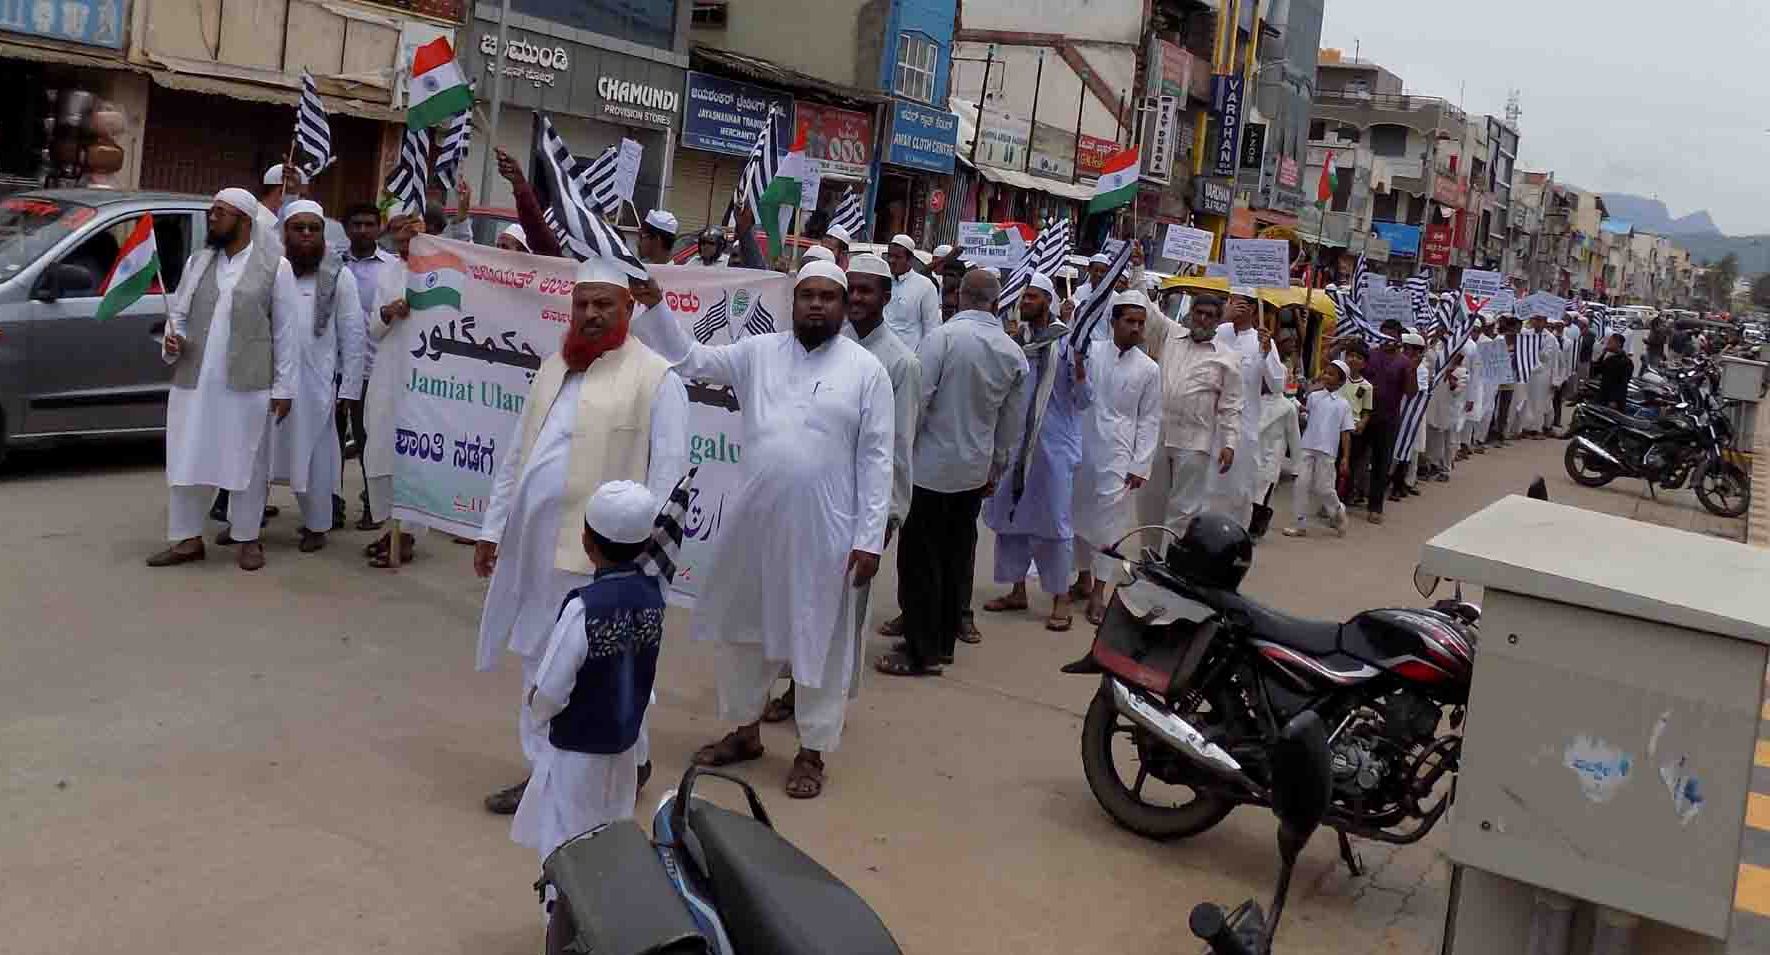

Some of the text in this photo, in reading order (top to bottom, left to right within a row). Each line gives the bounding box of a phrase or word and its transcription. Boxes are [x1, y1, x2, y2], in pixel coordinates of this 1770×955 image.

[598, 77, 680, 113] CHAMUNDI
[604, 104, 672, 126] PROVISION STORES
[1219, 79, 1240, 162] VARDHAN
[912, 136, 932, 152] CLOTH
[405, 367, 475, 404] Jamiat
[689, 431, 741, 465] galu
